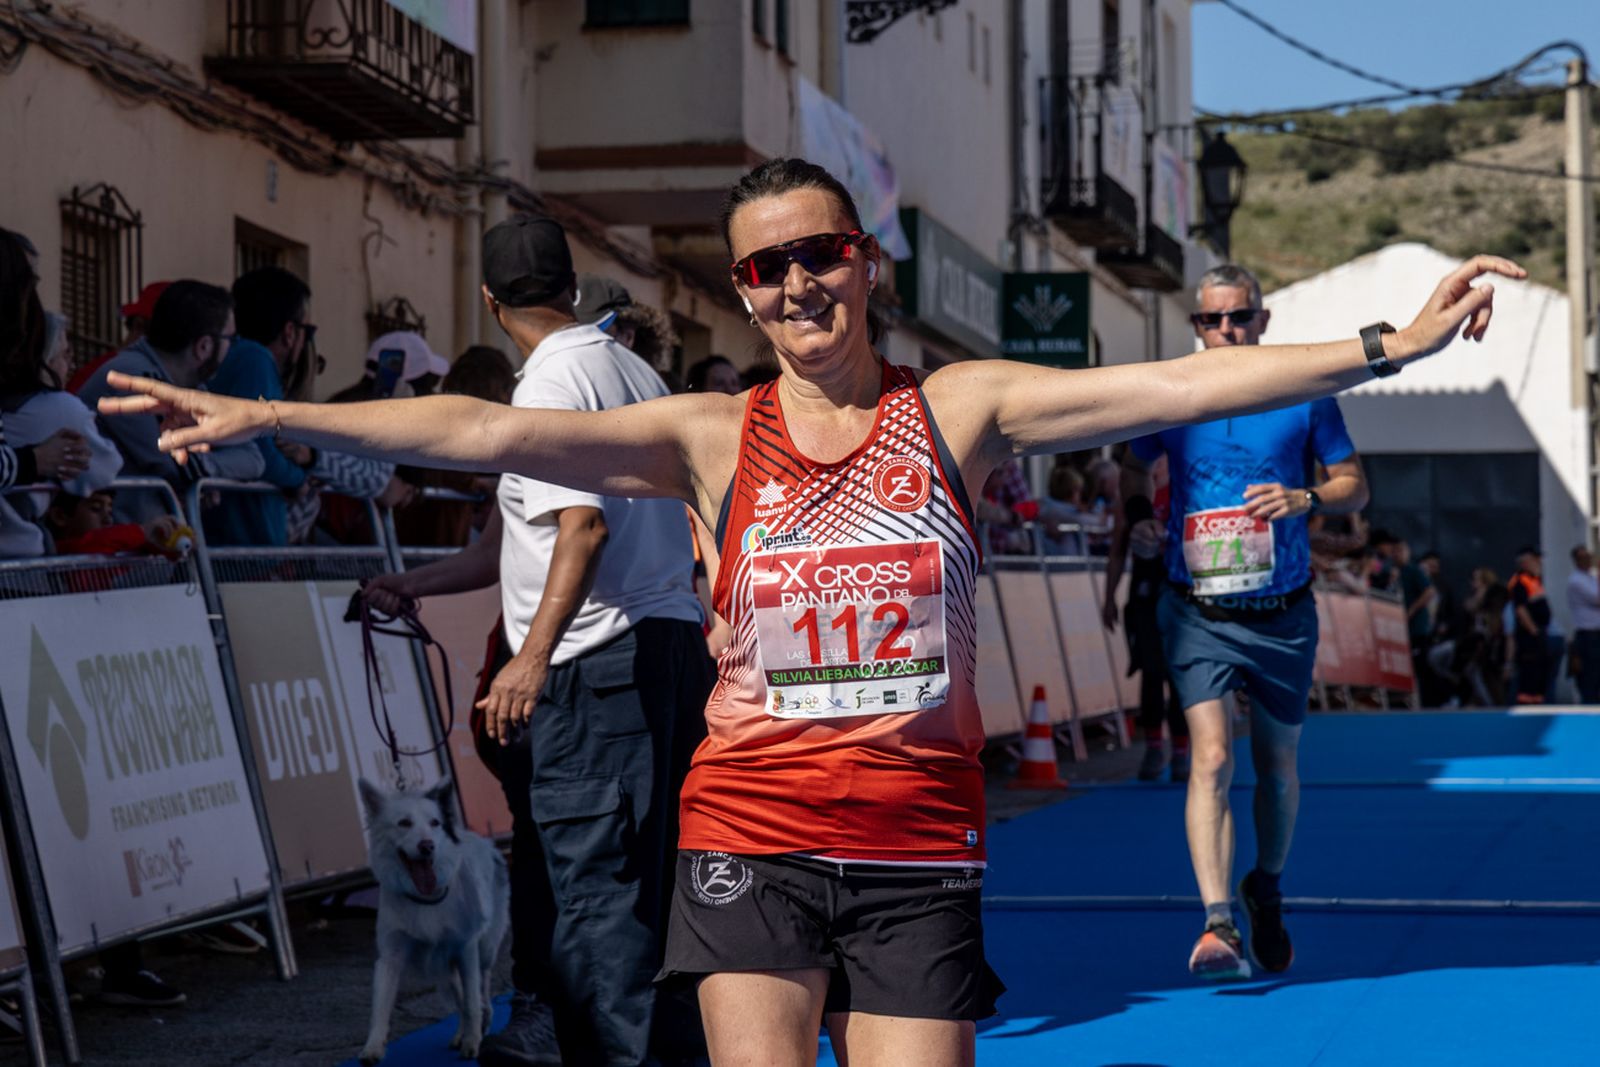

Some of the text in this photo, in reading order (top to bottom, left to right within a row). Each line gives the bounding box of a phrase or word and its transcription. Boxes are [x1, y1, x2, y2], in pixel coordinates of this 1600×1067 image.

[754, 503, 787, 518] luanvi
[1194, 516, 1207, 532] X
[1206, 537, 1245, 568] 71
[779, 558, 808, 590] X
[814, 560, 911, 588] CROSS
[781, 586, 890, 612] PANTANO
[793, 602, 912, 665] 112
[772, 669, 813, 684] SILVIA
[250, 678, 339, 781] UNED
[111, 780, 241, 832] FRANCHISING NETWORK
